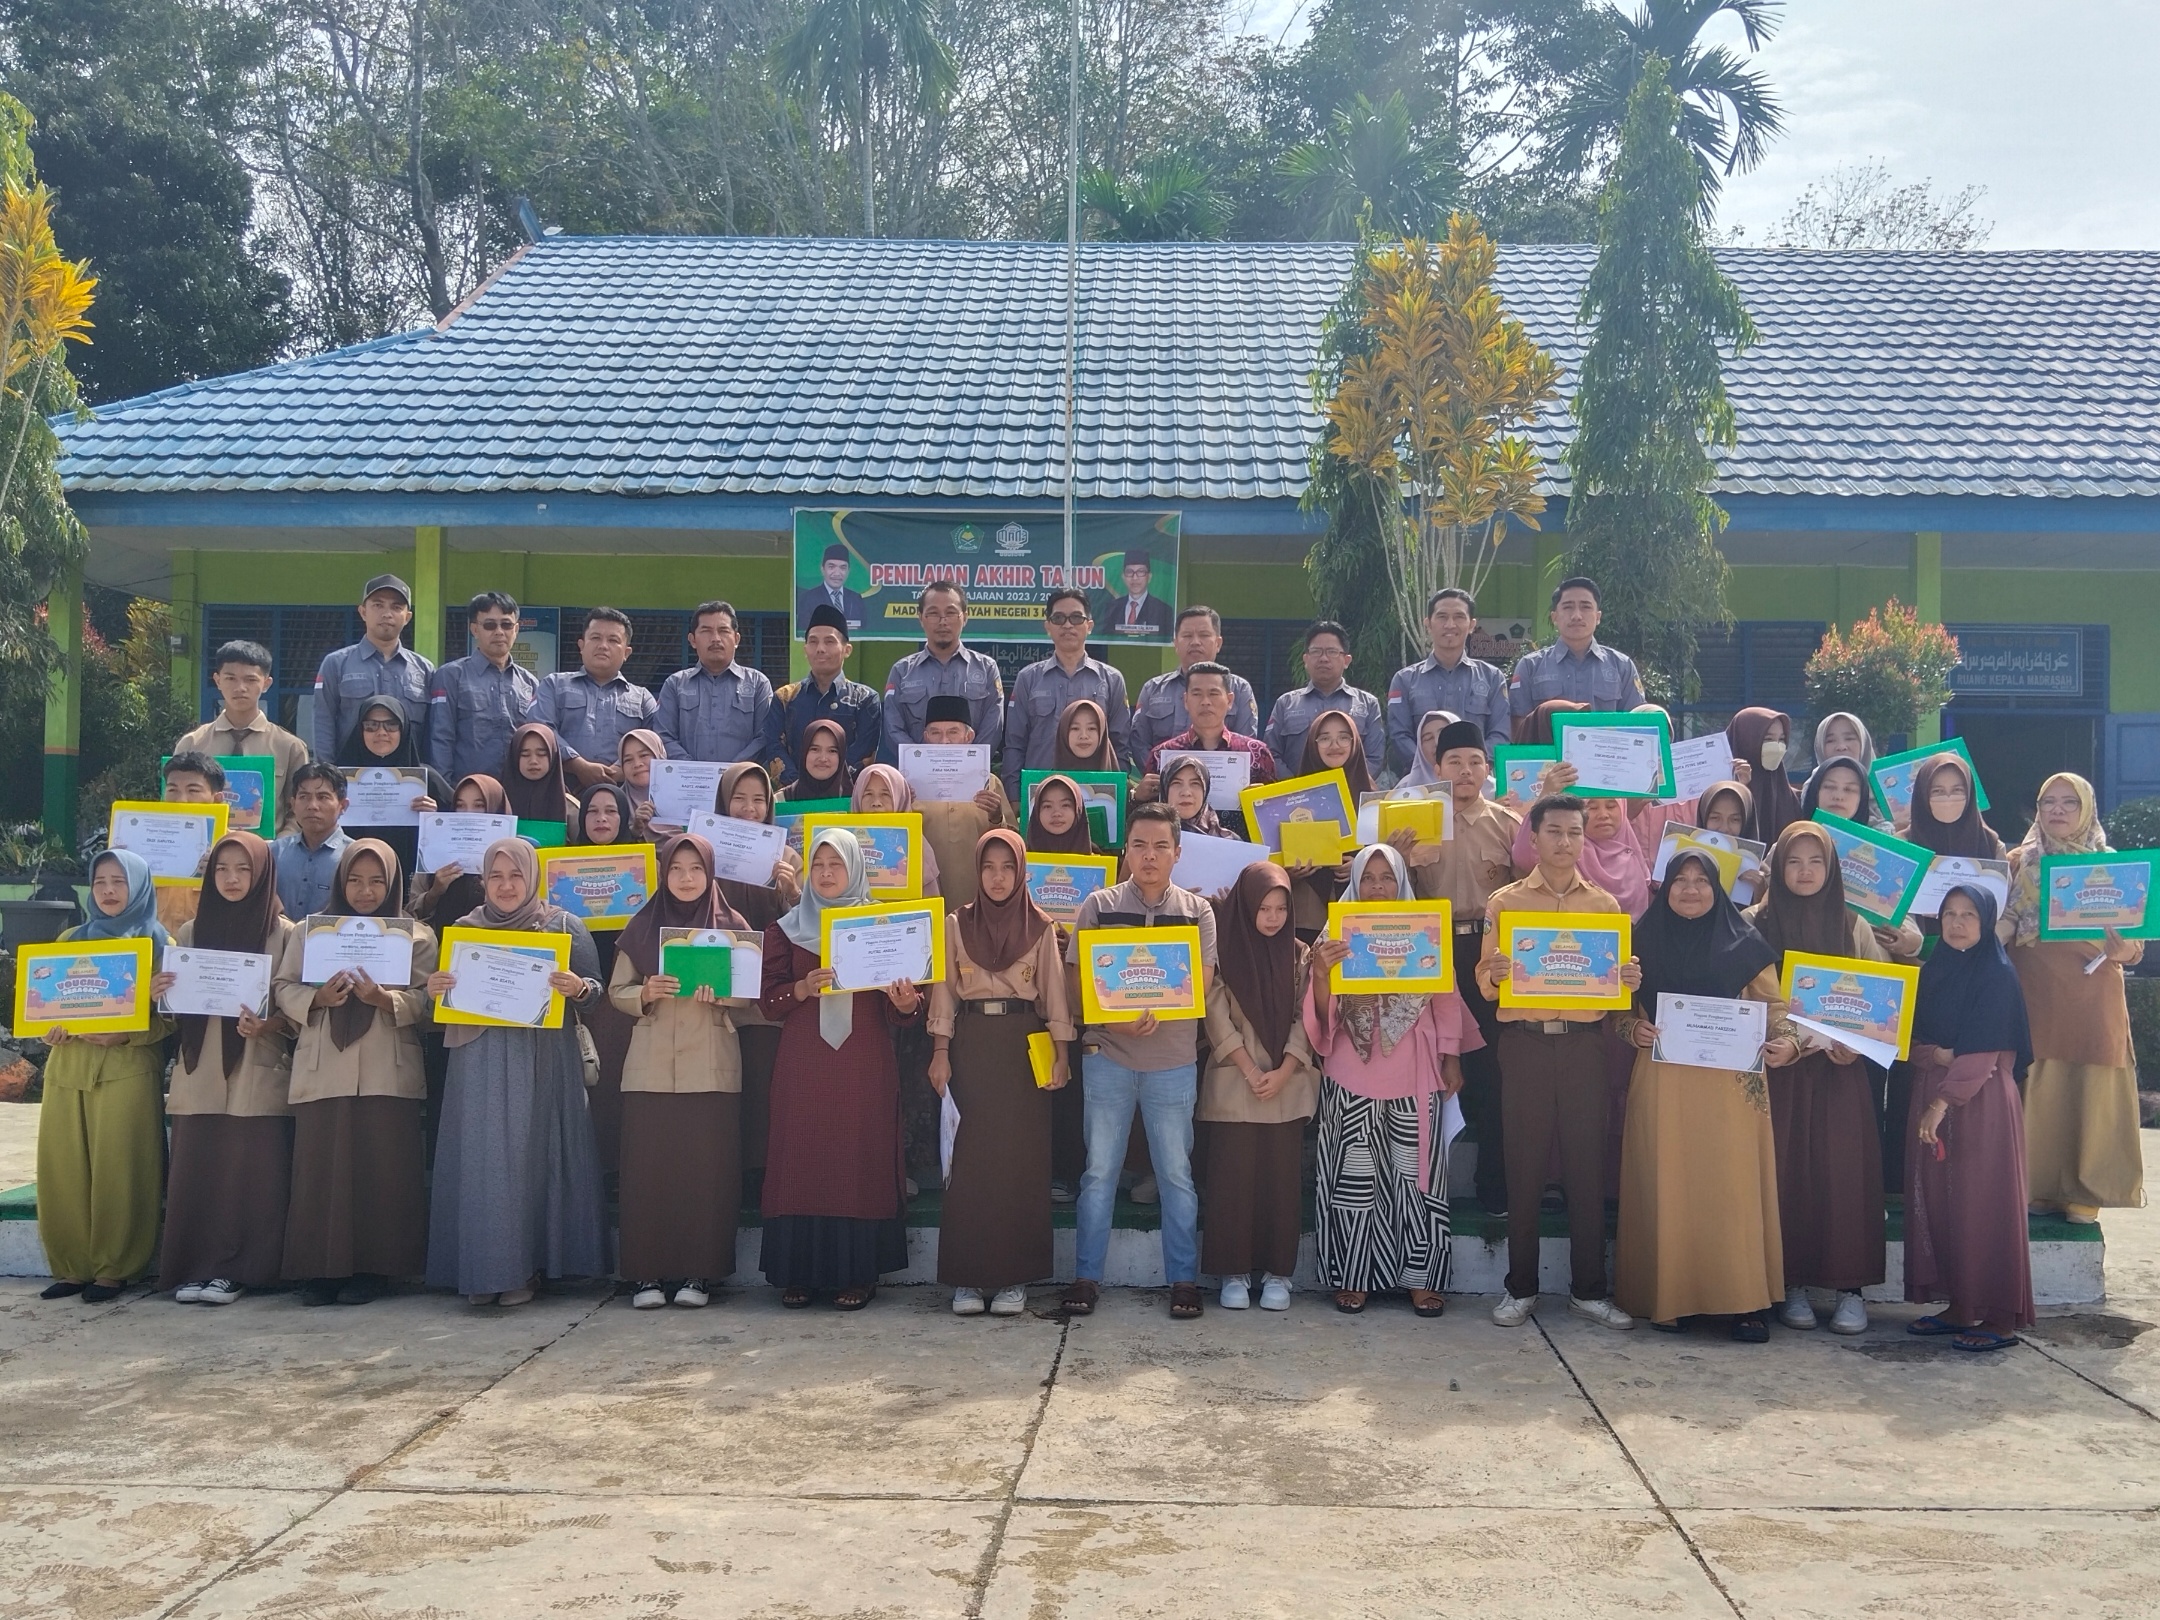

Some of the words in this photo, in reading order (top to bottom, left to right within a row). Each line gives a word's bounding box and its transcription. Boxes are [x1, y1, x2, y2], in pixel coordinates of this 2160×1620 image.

[870, 563, 969, 587] PENILAIAN
[975, 565, 1034, 587] AKHIR
[1006, 592, 1030, 601] 2023
[994, 607, 1030, 617] NEGERI
[1033, 608, 1039, 617] 3
[1470, 648, 1520, 657] NASIONA
[1958, 675, 1986, 685] RUANG
[1989, 675, 2024, 685] KEPALA
[2027, 675, 2072, 685] MADRASAH
[574, 884, 622, 896] VOUCHER
[1035, 885, 1081, 897] VOUCHER
[2075, 888, 2124, 900] VOUCHER
[1367, 943, 1416, 956] VOUCHER
[1539, 953, 1591, 967] VOUCHER
[1118, 967, 1167, 980] VOUCHER
[55, 978, 109, 991] VOUCHER
[1818, 995, 1873, 1012] VOUCHER
